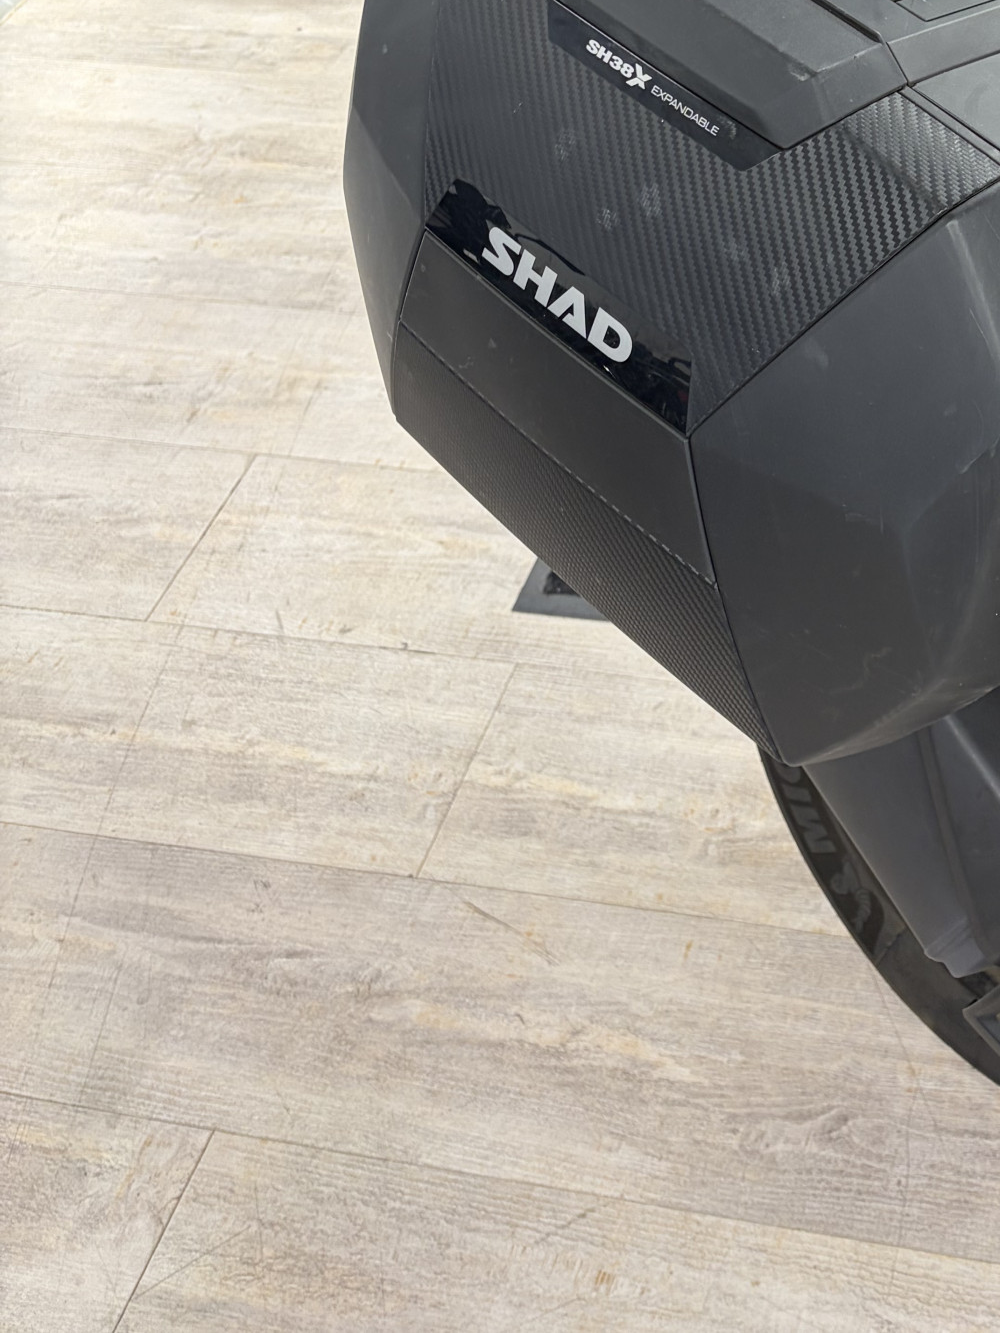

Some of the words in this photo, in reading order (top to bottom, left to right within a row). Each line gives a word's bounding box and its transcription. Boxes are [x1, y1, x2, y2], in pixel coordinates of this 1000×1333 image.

[586, 39, 652, 90] SH38X
[651, 85, 720, 136] EXPANDABLE
[481, 226, 634, 363] SHAD
